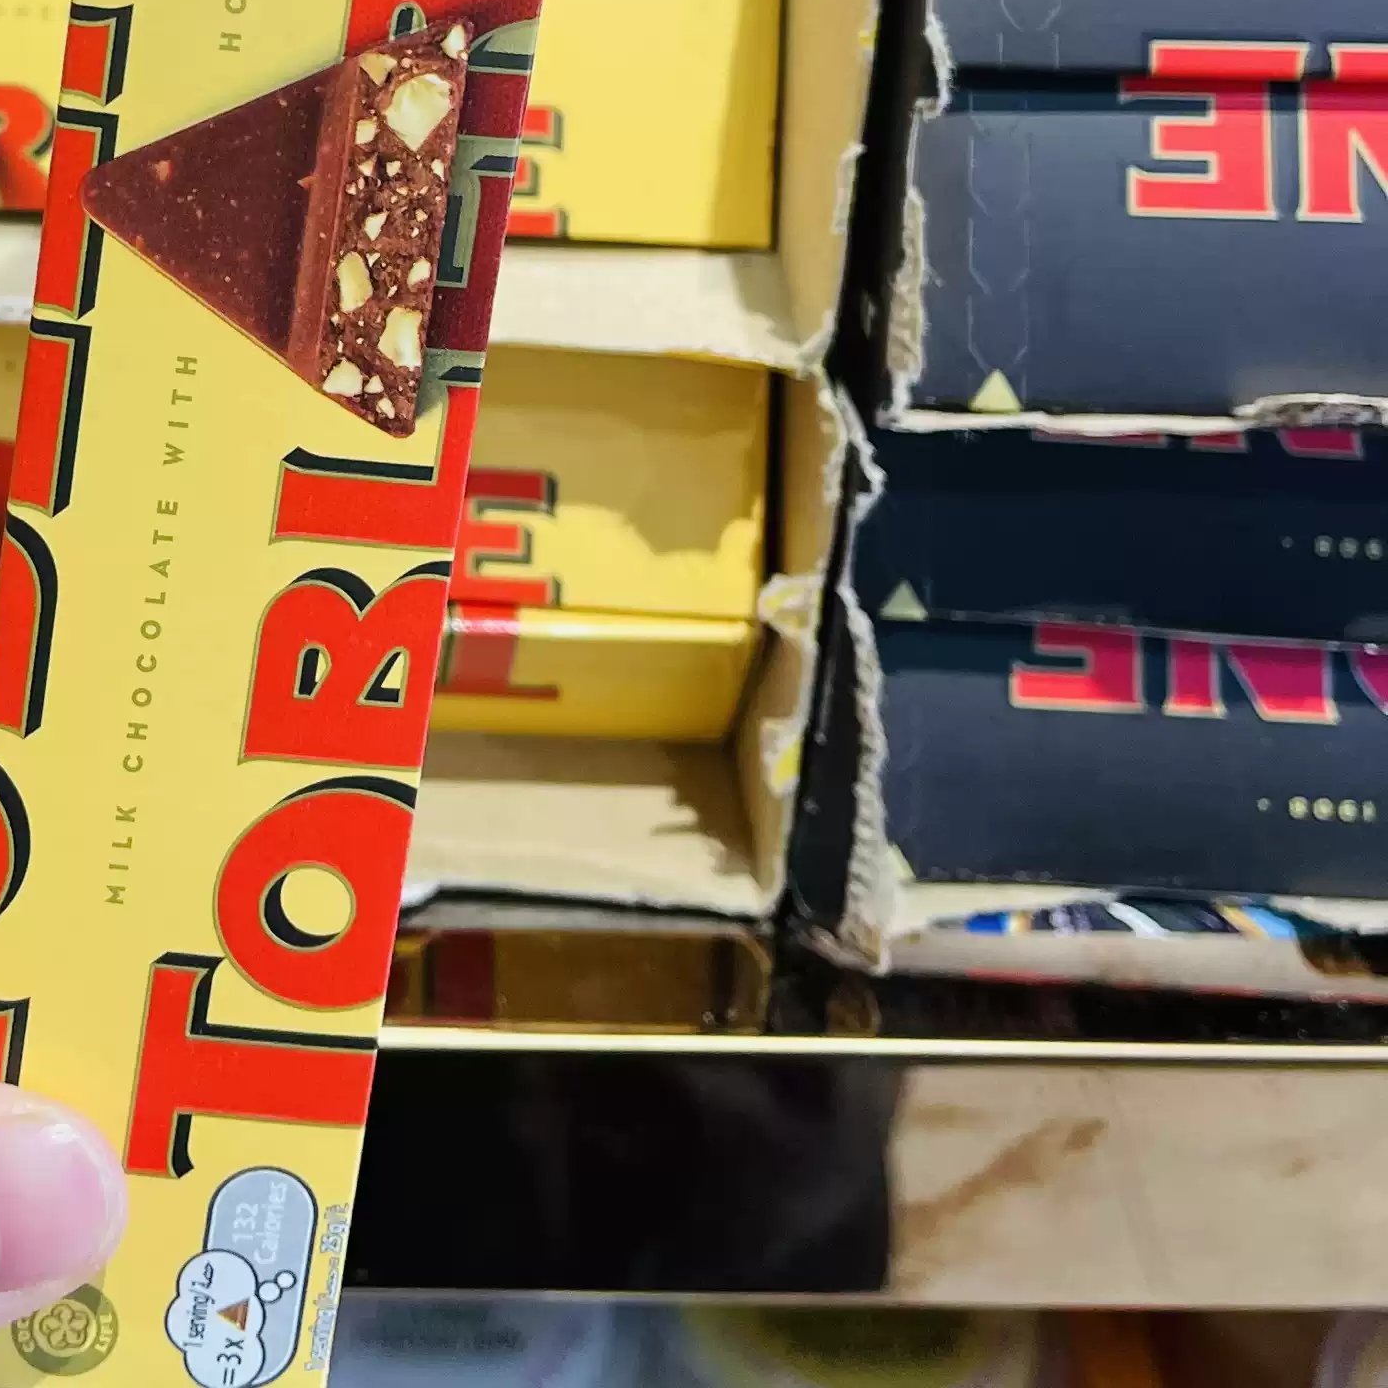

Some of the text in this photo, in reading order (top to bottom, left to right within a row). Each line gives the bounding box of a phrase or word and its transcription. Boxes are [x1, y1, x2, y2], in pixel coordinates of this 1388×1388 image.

[104, 805, 137, 905] MILK
[122, 498, 180, 772] CHOCOLATE
[163, 354, 198, 467] WITH
[232, 1202, 259, 1244] 132
[253, 1180, 288, 1265] Calories
